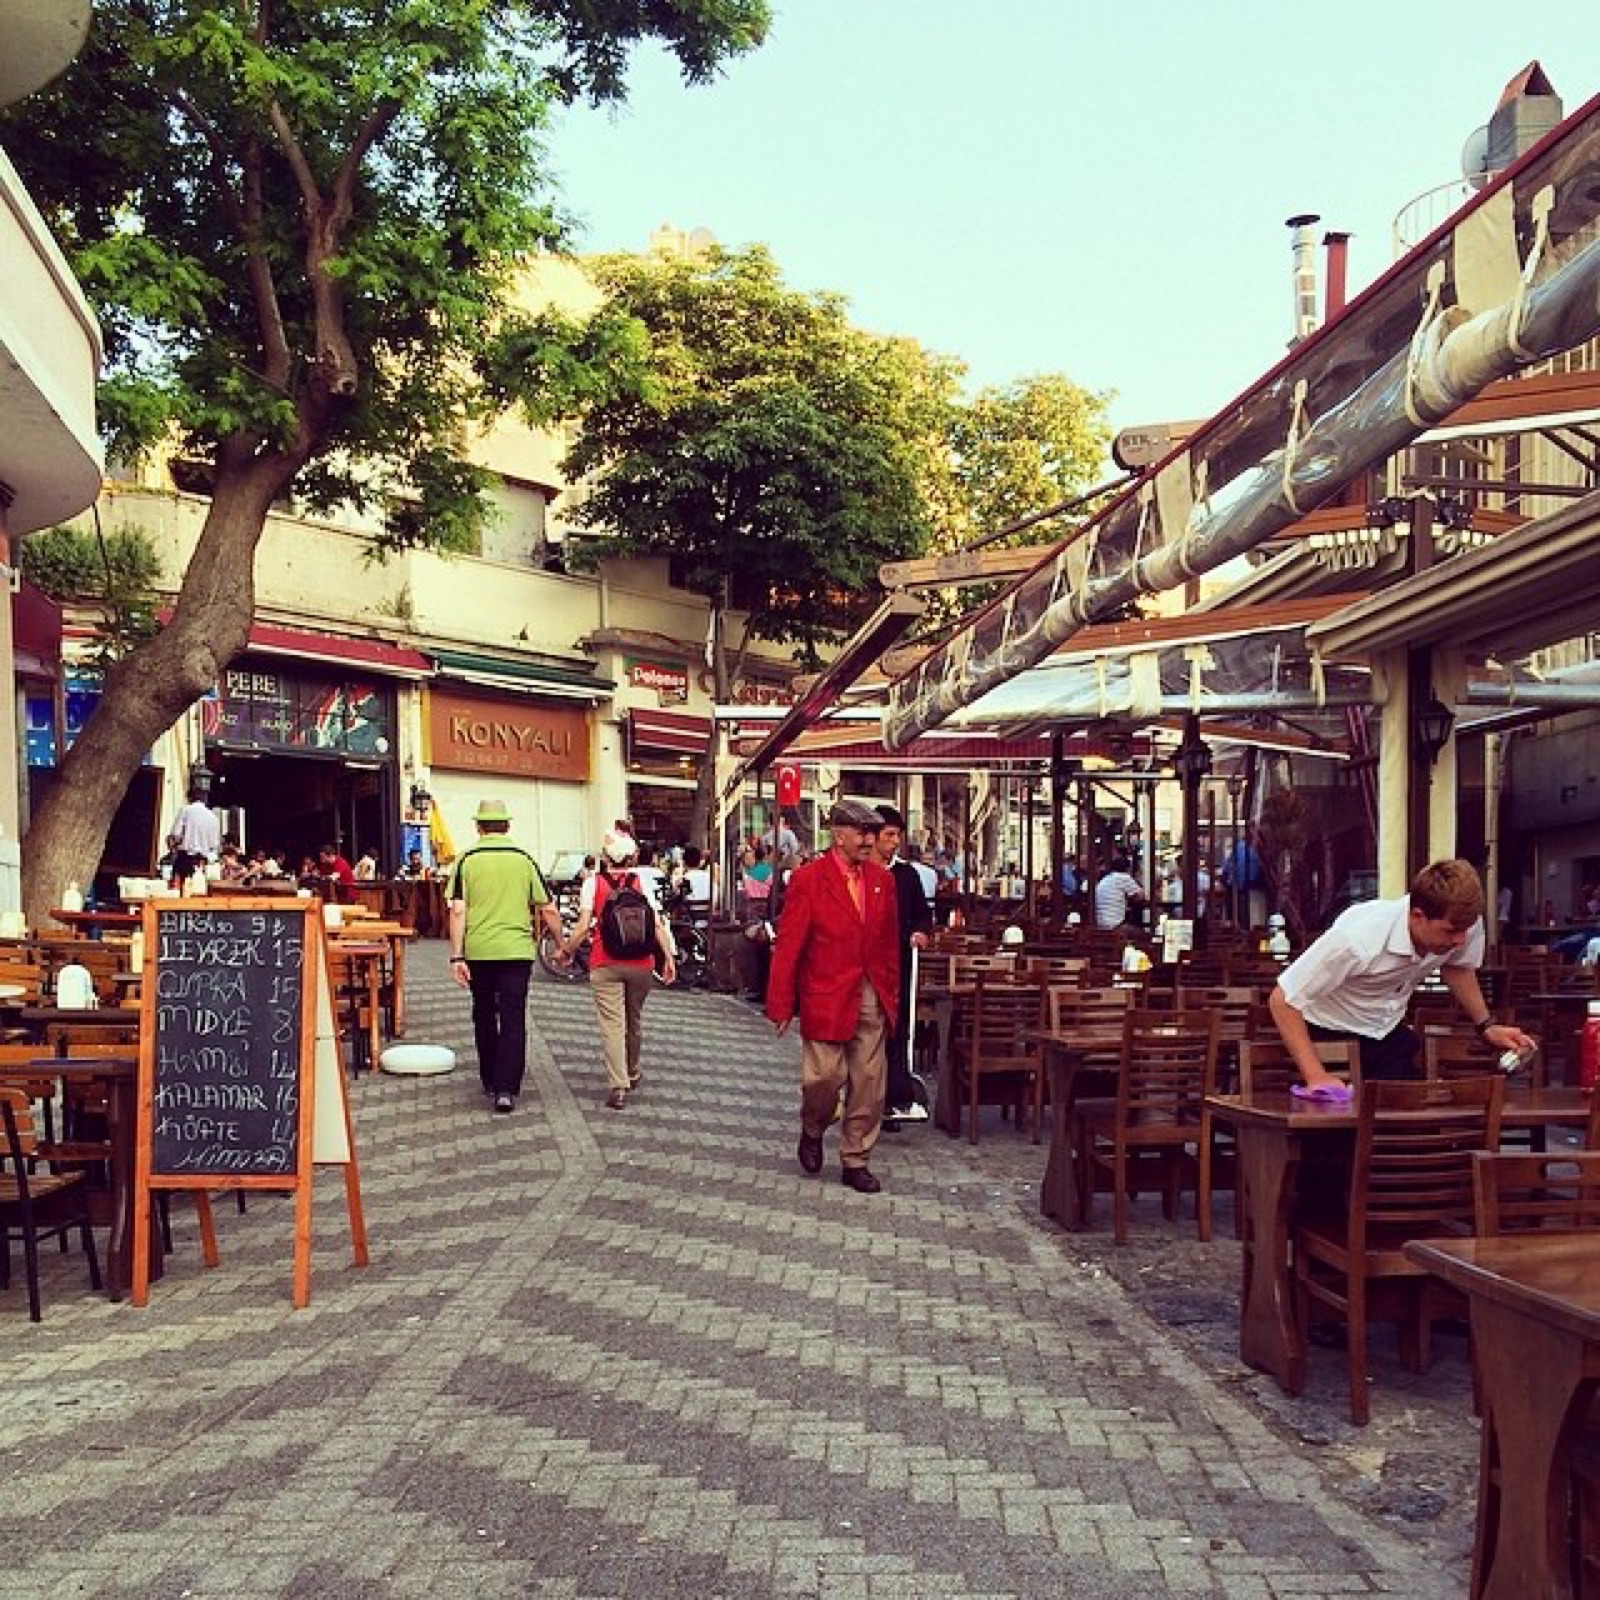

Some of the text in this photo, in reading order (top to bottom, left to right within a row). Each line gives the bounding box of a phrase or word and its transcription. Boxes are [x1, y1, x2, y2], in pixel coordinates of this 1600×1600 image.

[451, 716, 571, 756] KONYALI
[159, 937, 266, 967] LEVREK
[155, 1082, 269, 1112] KALAMAR
